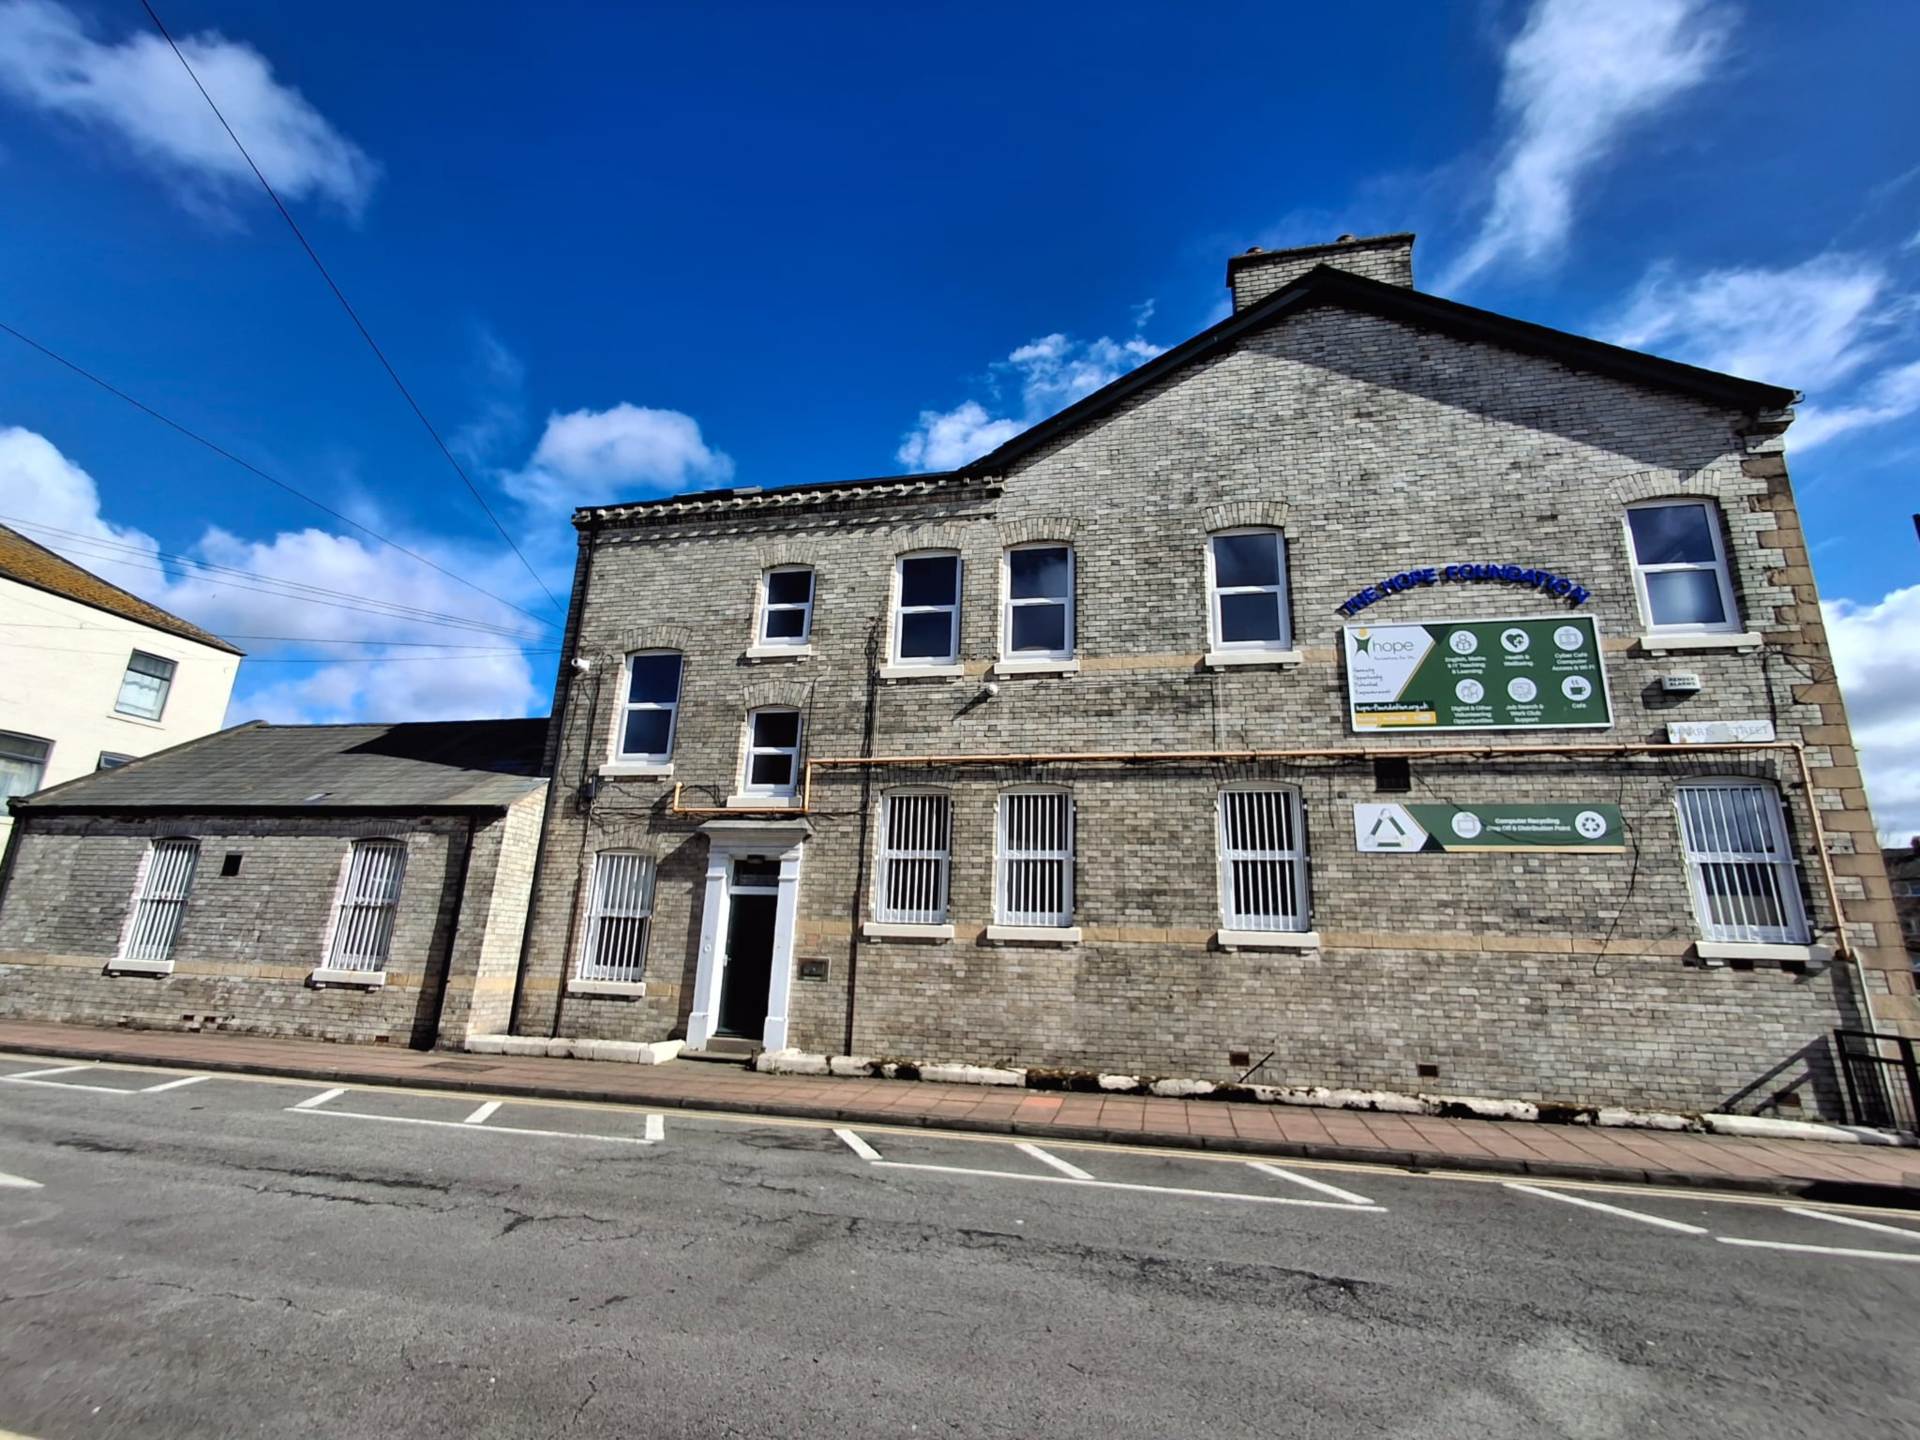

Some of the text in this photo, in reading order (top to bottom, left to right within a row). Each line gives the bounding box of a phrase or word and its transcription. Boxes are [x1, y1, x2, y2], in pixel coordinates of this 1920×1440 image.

[1338, 563, 1592, 617] THE HOPE FOUNDATION
[1373, 640, 1414, 655] hope
